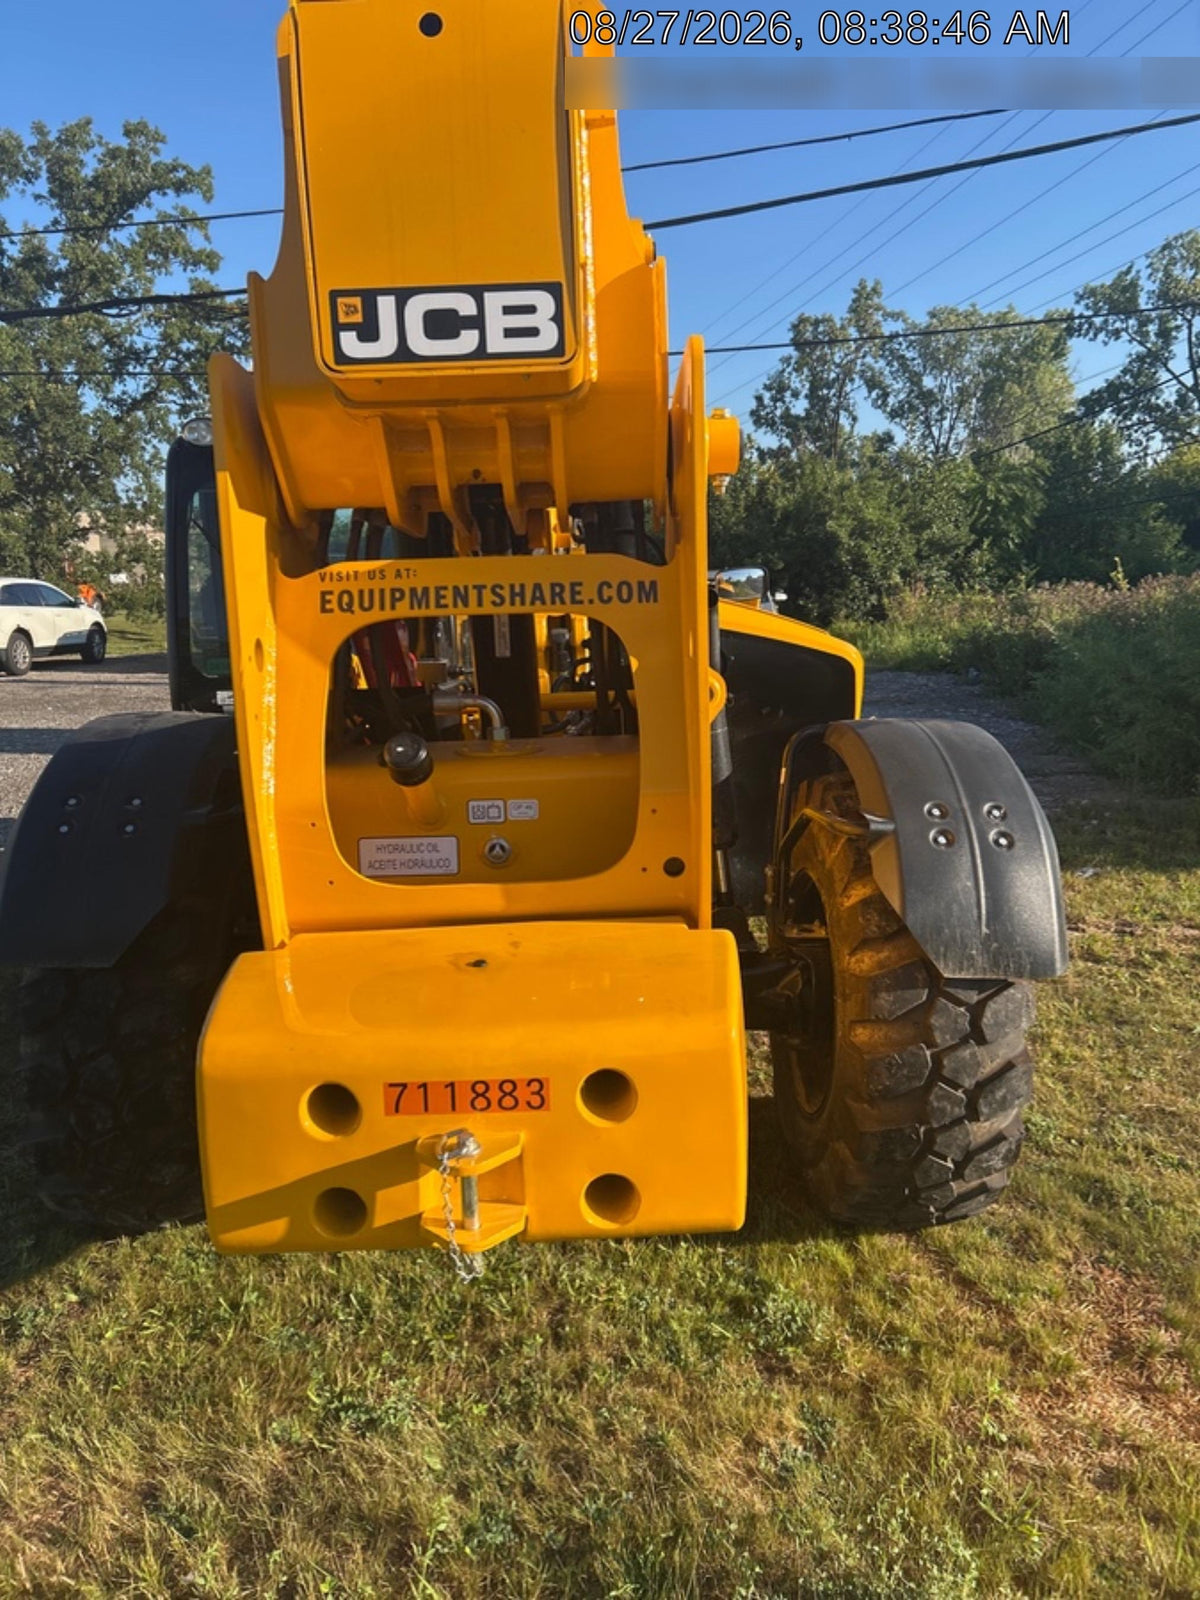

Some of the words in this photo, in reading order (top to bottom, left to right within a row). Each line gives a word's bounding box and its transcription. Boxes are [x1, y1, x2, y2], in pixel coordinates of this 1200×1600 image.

[339, 289, 559, 359] JCB
[319, 570, 360, 583] VISIT
[367, 569, 386, 581] US
[394, 568, 417, 580] AT:
[319, 579, 659, 615] EQUIPMENTSHARE.COM
[375, 842, 425, 854] HYDRAULIC
[426, 842, 441, 853] OIL
[367, 858, 397, 870] ACEITE
[387, 1078, 546, 1113] 711883
